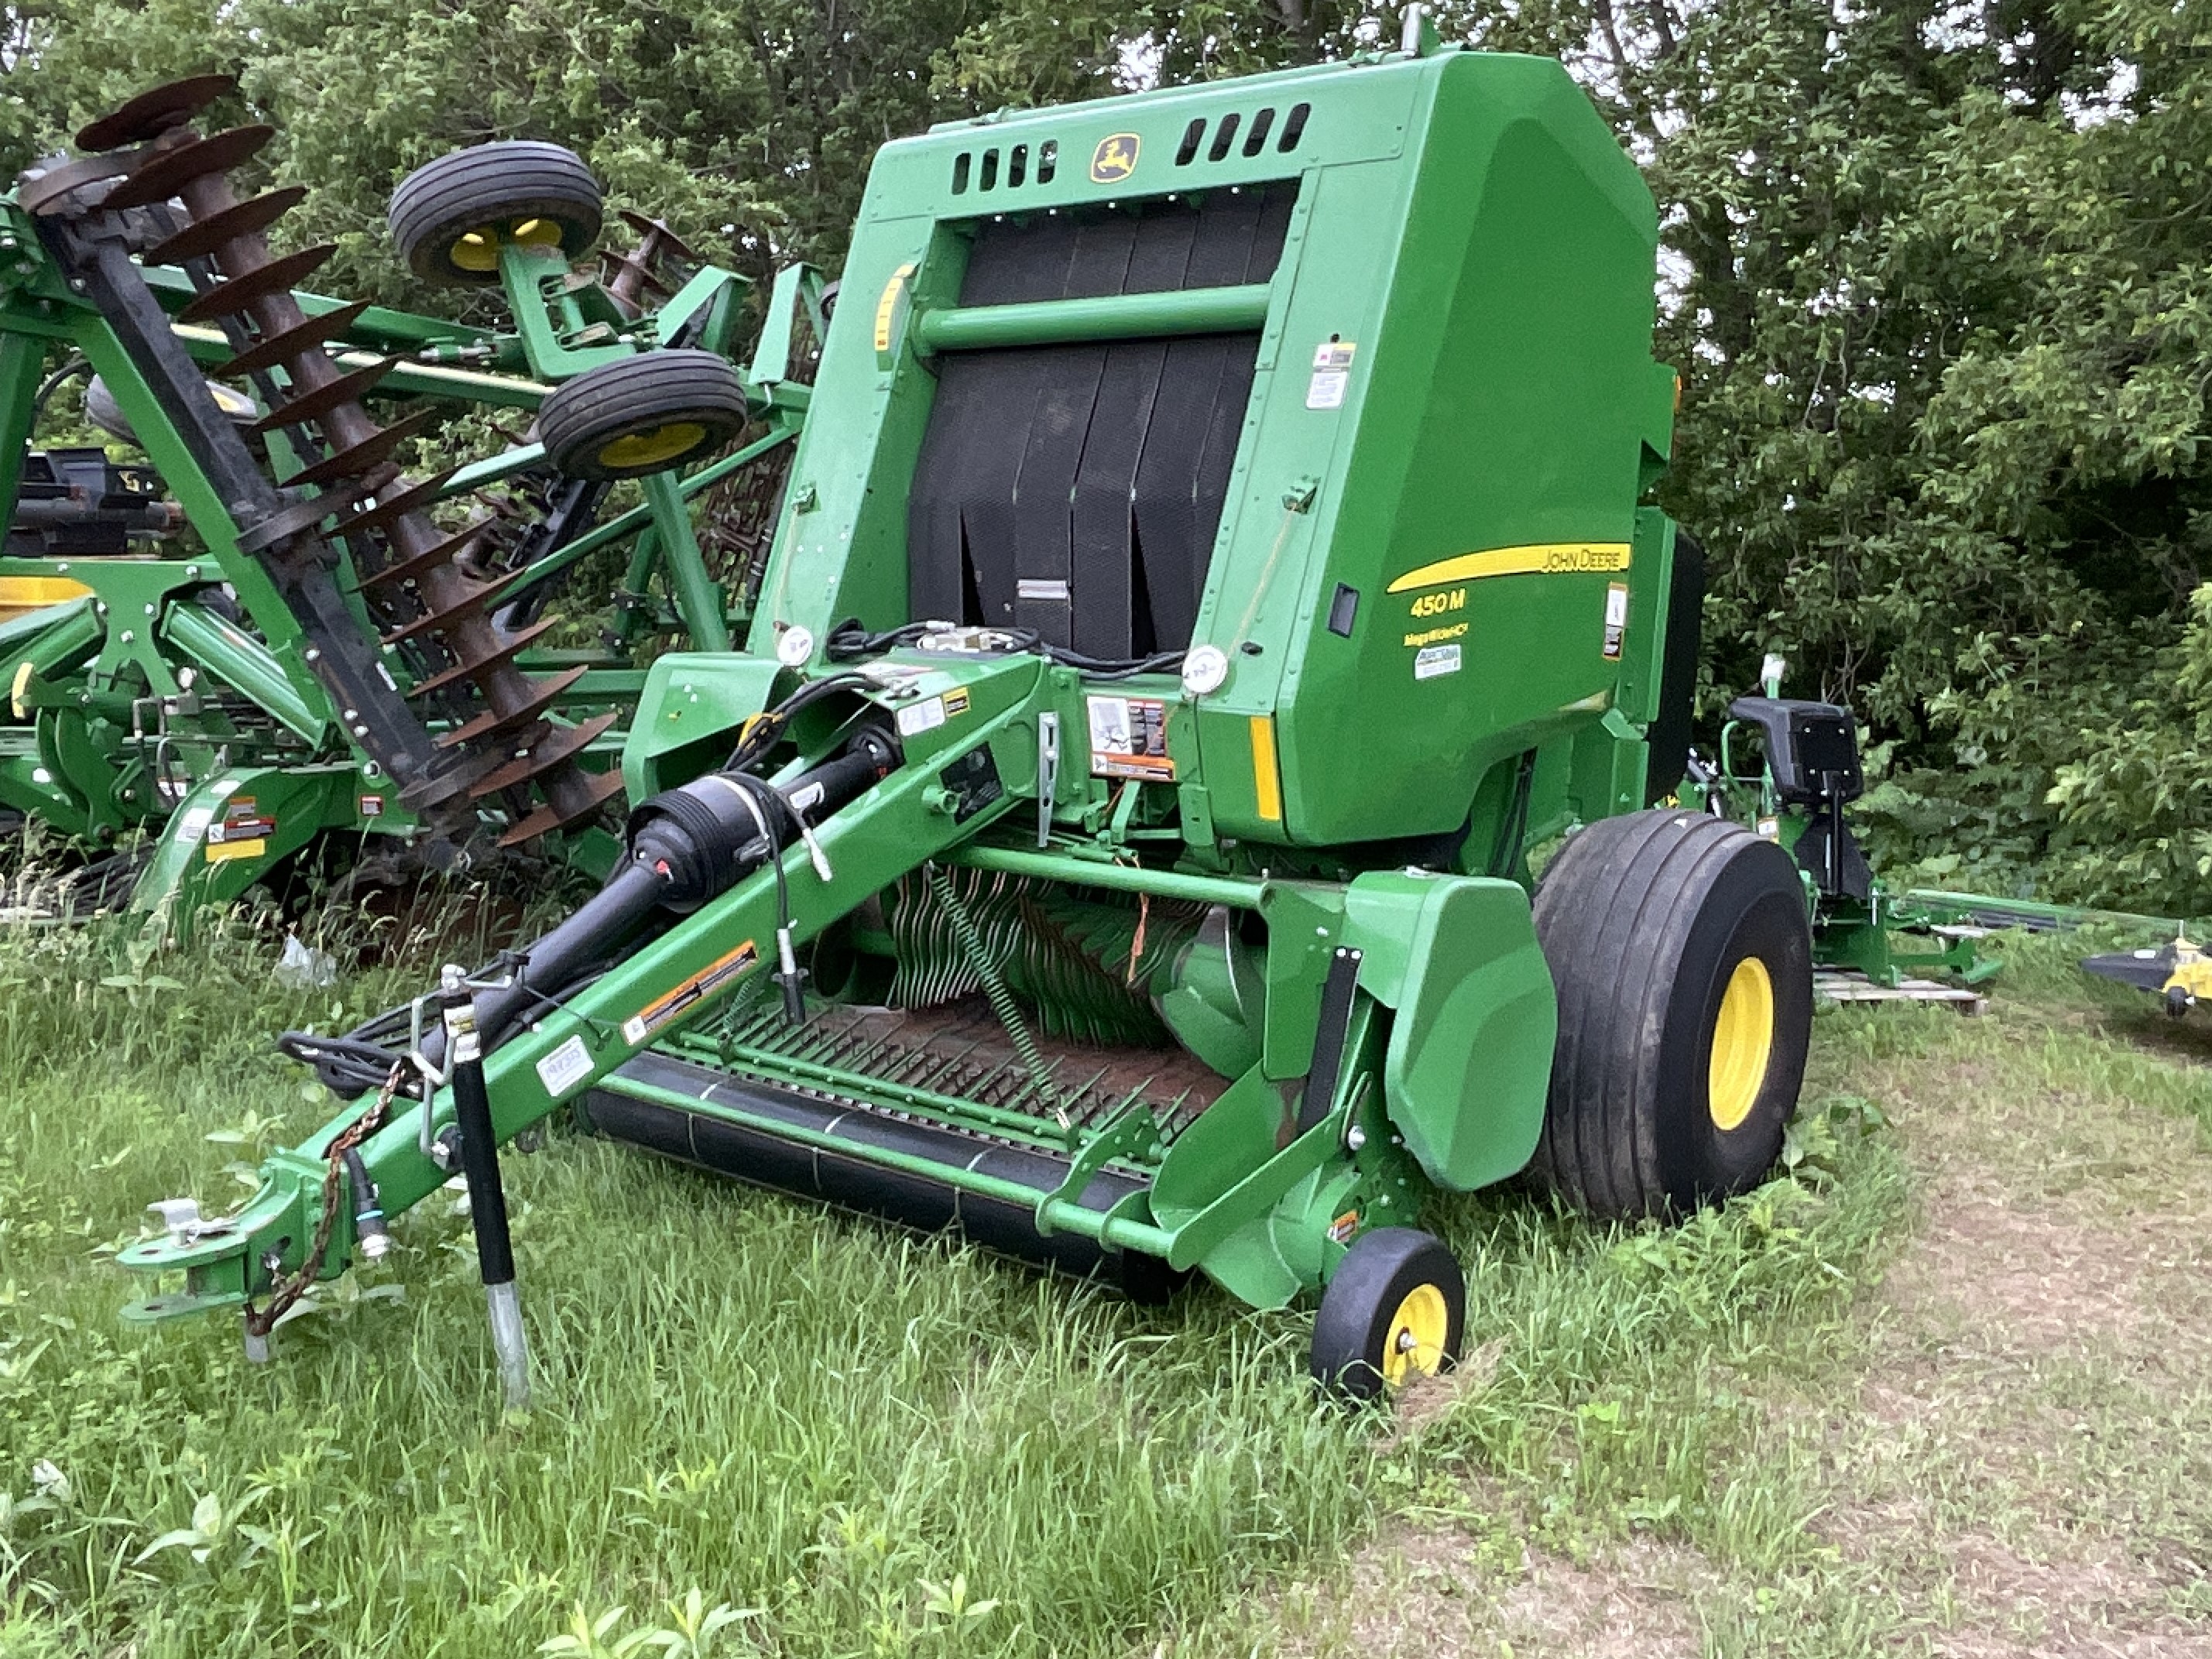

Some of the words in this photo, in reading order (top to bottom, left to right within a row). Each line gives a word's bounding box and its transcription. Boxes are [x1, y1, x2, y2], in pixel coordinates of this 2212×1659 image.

[1542, 549, 1578, 569] JOHN
[1581, 547, 1620, 567] DEERE
[1410, 592, 1447, 618] 450
[1449, 588, 1466, 610] M
